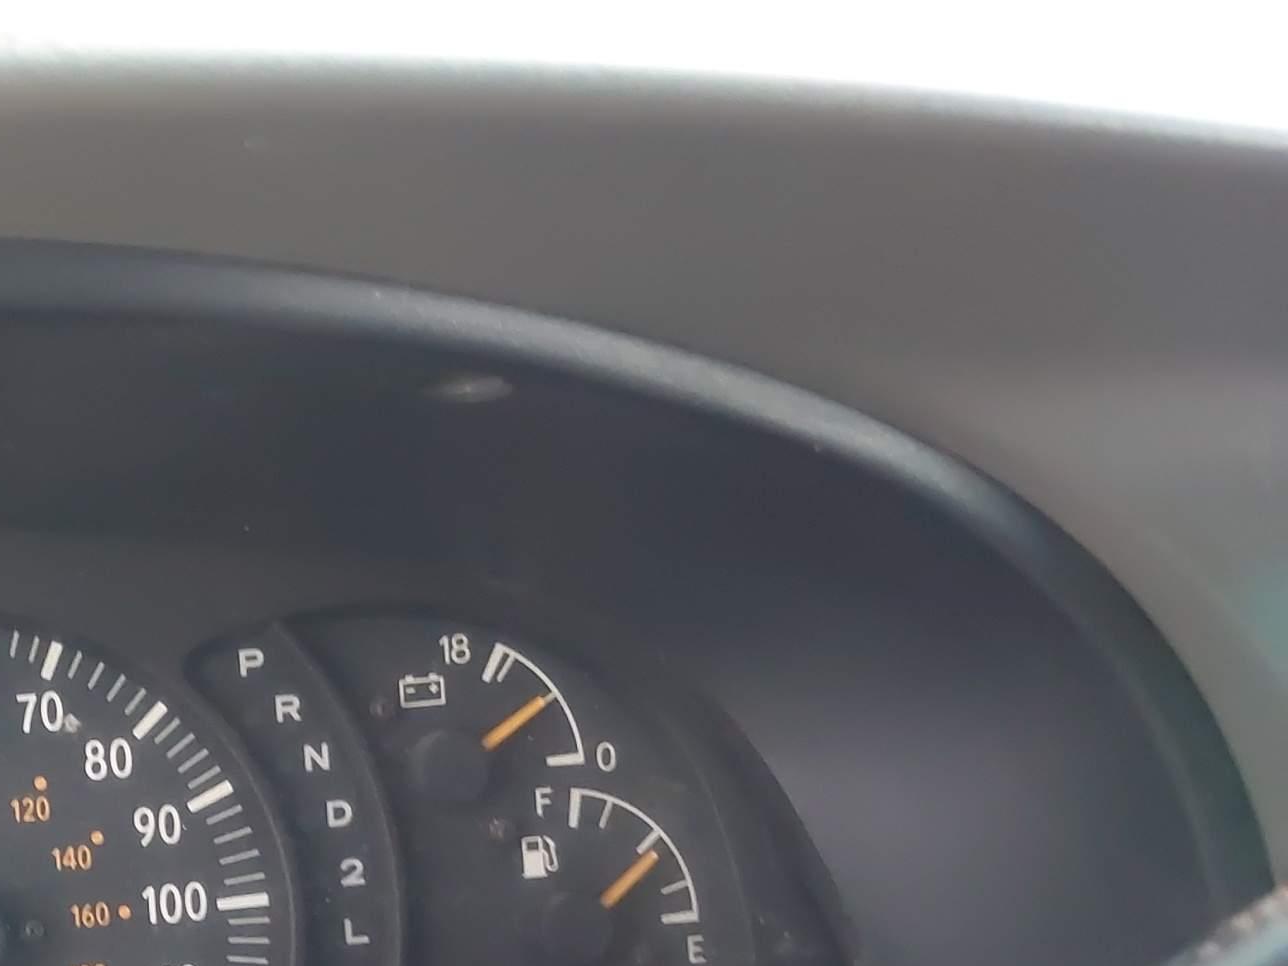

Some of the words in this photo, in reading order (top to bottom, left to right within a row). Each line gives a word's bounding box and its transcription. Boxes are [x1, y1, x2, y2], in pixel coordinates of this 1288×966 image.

[238, 648, 265, 678] P
[439, 633, 471, 665] 18
[16, 690, 64, 734] 70
[275, 694, 302, 723] R
[84, 737, 133, 781] 80
[303, 742, 330, 772] N
[596, 741, 617, 772] 0
[10, 795, 52, 823] 120
[326, 799, 353, 828] D
[534, 786, 553, 817] F
[133, 804, 182, 847] 90
[52, 845, 93, 872] 140
[340, 857, 366, 887] 2
[70, 902, 111, 929] 160
[142, 881, 208, 925] 100
[343, 918, 370, 946] L
[686, 934, 708, 964] E
